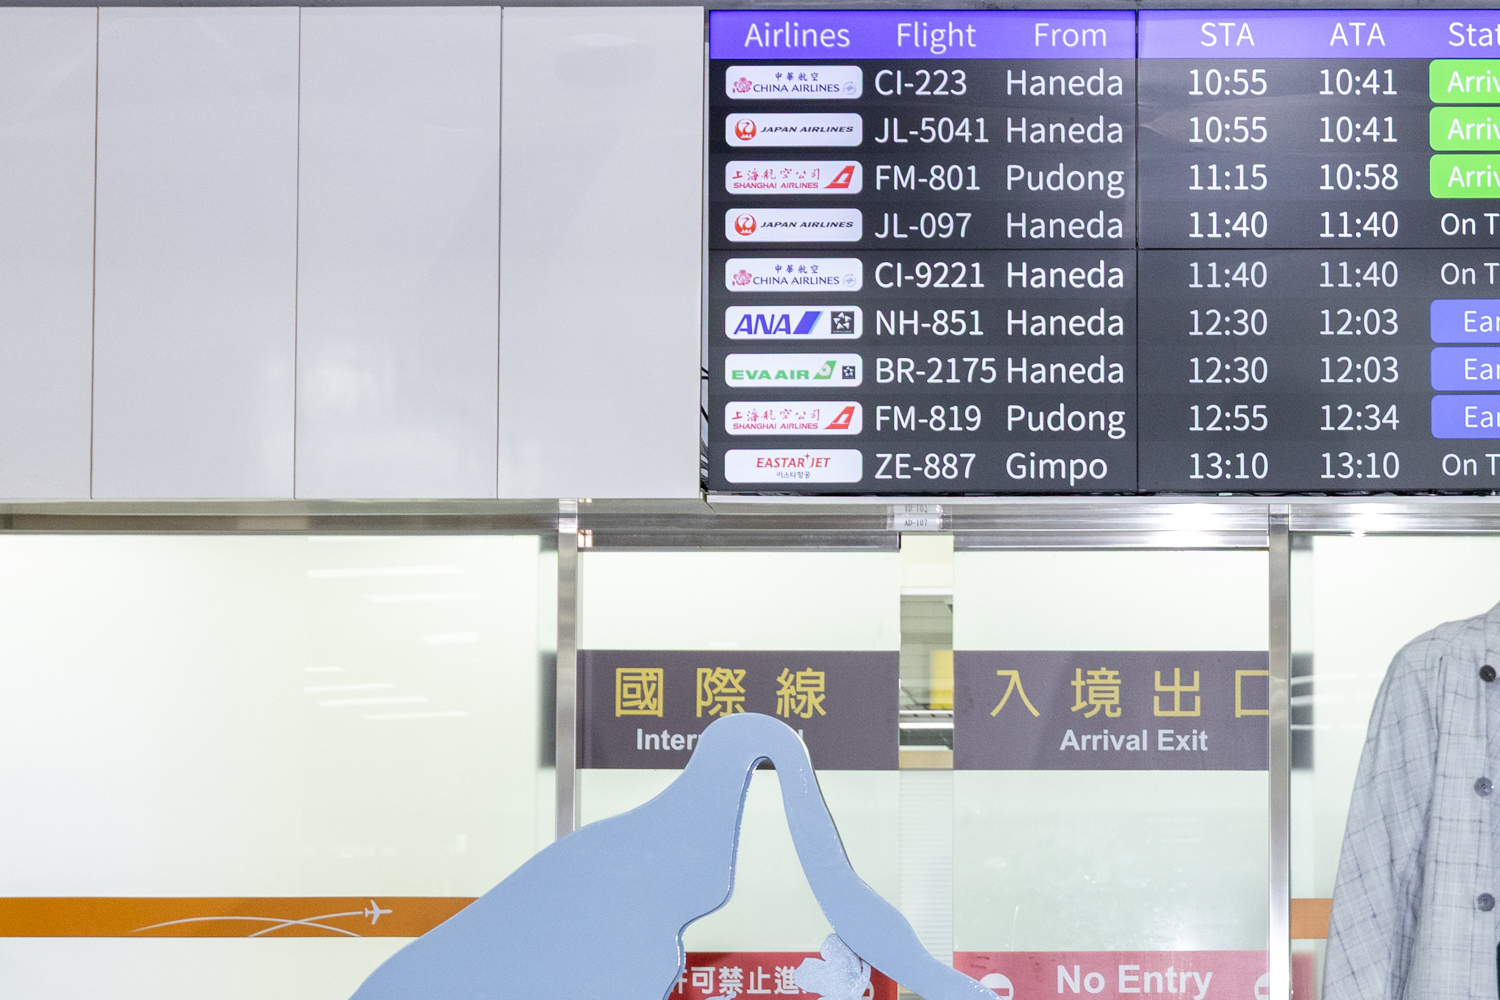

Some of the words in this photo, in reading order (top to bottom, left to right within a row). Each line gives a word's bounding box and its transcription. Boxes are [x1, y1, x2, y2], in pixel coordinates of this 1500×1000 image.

[744, 20, 851, 48] Airlines
[897, 20, 977, 55] Flight
[1035, 22, 1107, 48] From
[1200, 21, 1255, 47] STA
[1329, 22, 1386, 47] ATA
[753, 84, 789, 93] CHINA
[791, 84, 840, 93] AIRLINES
[775, 71, 819, 82] 中華航空
[874, 69, 967, 96] CI-223
[1007, 67, 1123, 96] Haneda
[1188, 68, 1268, 96] 10:55
[1319, 68, 1398, 96] 10:41
[874, 116, 989, 144] JL-5041
[1007, 114, 1123, 144] Haneda
[1188, 116, 1268, 143] 10:55
[1319, 115, 1398, 143] 10:41
[876, 164, 981, 191] FM-801
[1007, 162, 1125, 200] Pudong
[1188, 163, 1268, 191] 11:15
[1319, 163, 1399, 191] 10:58
[874, 212, 972, 239] JL-097
[1007, 209, 1123, 239] Haneda
[1188, 210, 1268, 238] 11:40
[1319, 210, 1399, 238] 11:40
[1440, 212, 1476, 236] On
[875, 261, 985, 289] CI-9221
[1007, 259, 1124, 289] Haneda
[1188, 261, 1268, 289] 11:40
[1319, 260, 1399, 288] 11:40
[1440, 262, 1476, 285] On
[733, 314, 791, 335] ANA
[876, 309, 984, 336] NH-851
[1007, 307, 1124, 336] Haneda
[1188, 308, 1268, 336] 12:30
[1319, 308, 1399, 336] 12:03
[732, 370, 772, 380] EVA
[775, 370, 809, 380] AIR
[876, 357, 997, 384] BR-2175
[1007, 354, 1124, 384] Haneda
[1188, 356, 1268, 384] 12:30
[1320, 355, 1399, 384] 12:03
[876, 404, 982, 432] FM-819
[1007, 402, 1126, 440] Pudong
[1189, 404, 1268, 432] 12:55
[1320, 403, 1400, 431] 12:34
[756, 457, 805, 468] EASTAR
[809, 457, 831, 468] JET
[874, 452, 977, 480] ZE-887
[1006, 451, 1108, 487] Gimpo
[1189, 452, 1269, 480] 13:10
[1320, 451, 1400, 479] 13:10
[1441, 453, 1477, 477] On
[904, 519, 928, 527] AD-107
[614, 666, 828, 719] 國際線
[989, 666, 1269, 719] 入境出口
[1060, 729, 1148, 751] Arrival
[1157, 729, 1208, 751] Exit
[673, 966, 807, 995] 可禁止進
[1057, 964, 1105, 994] No
[1118, 964, 1213, 1000] Entry
